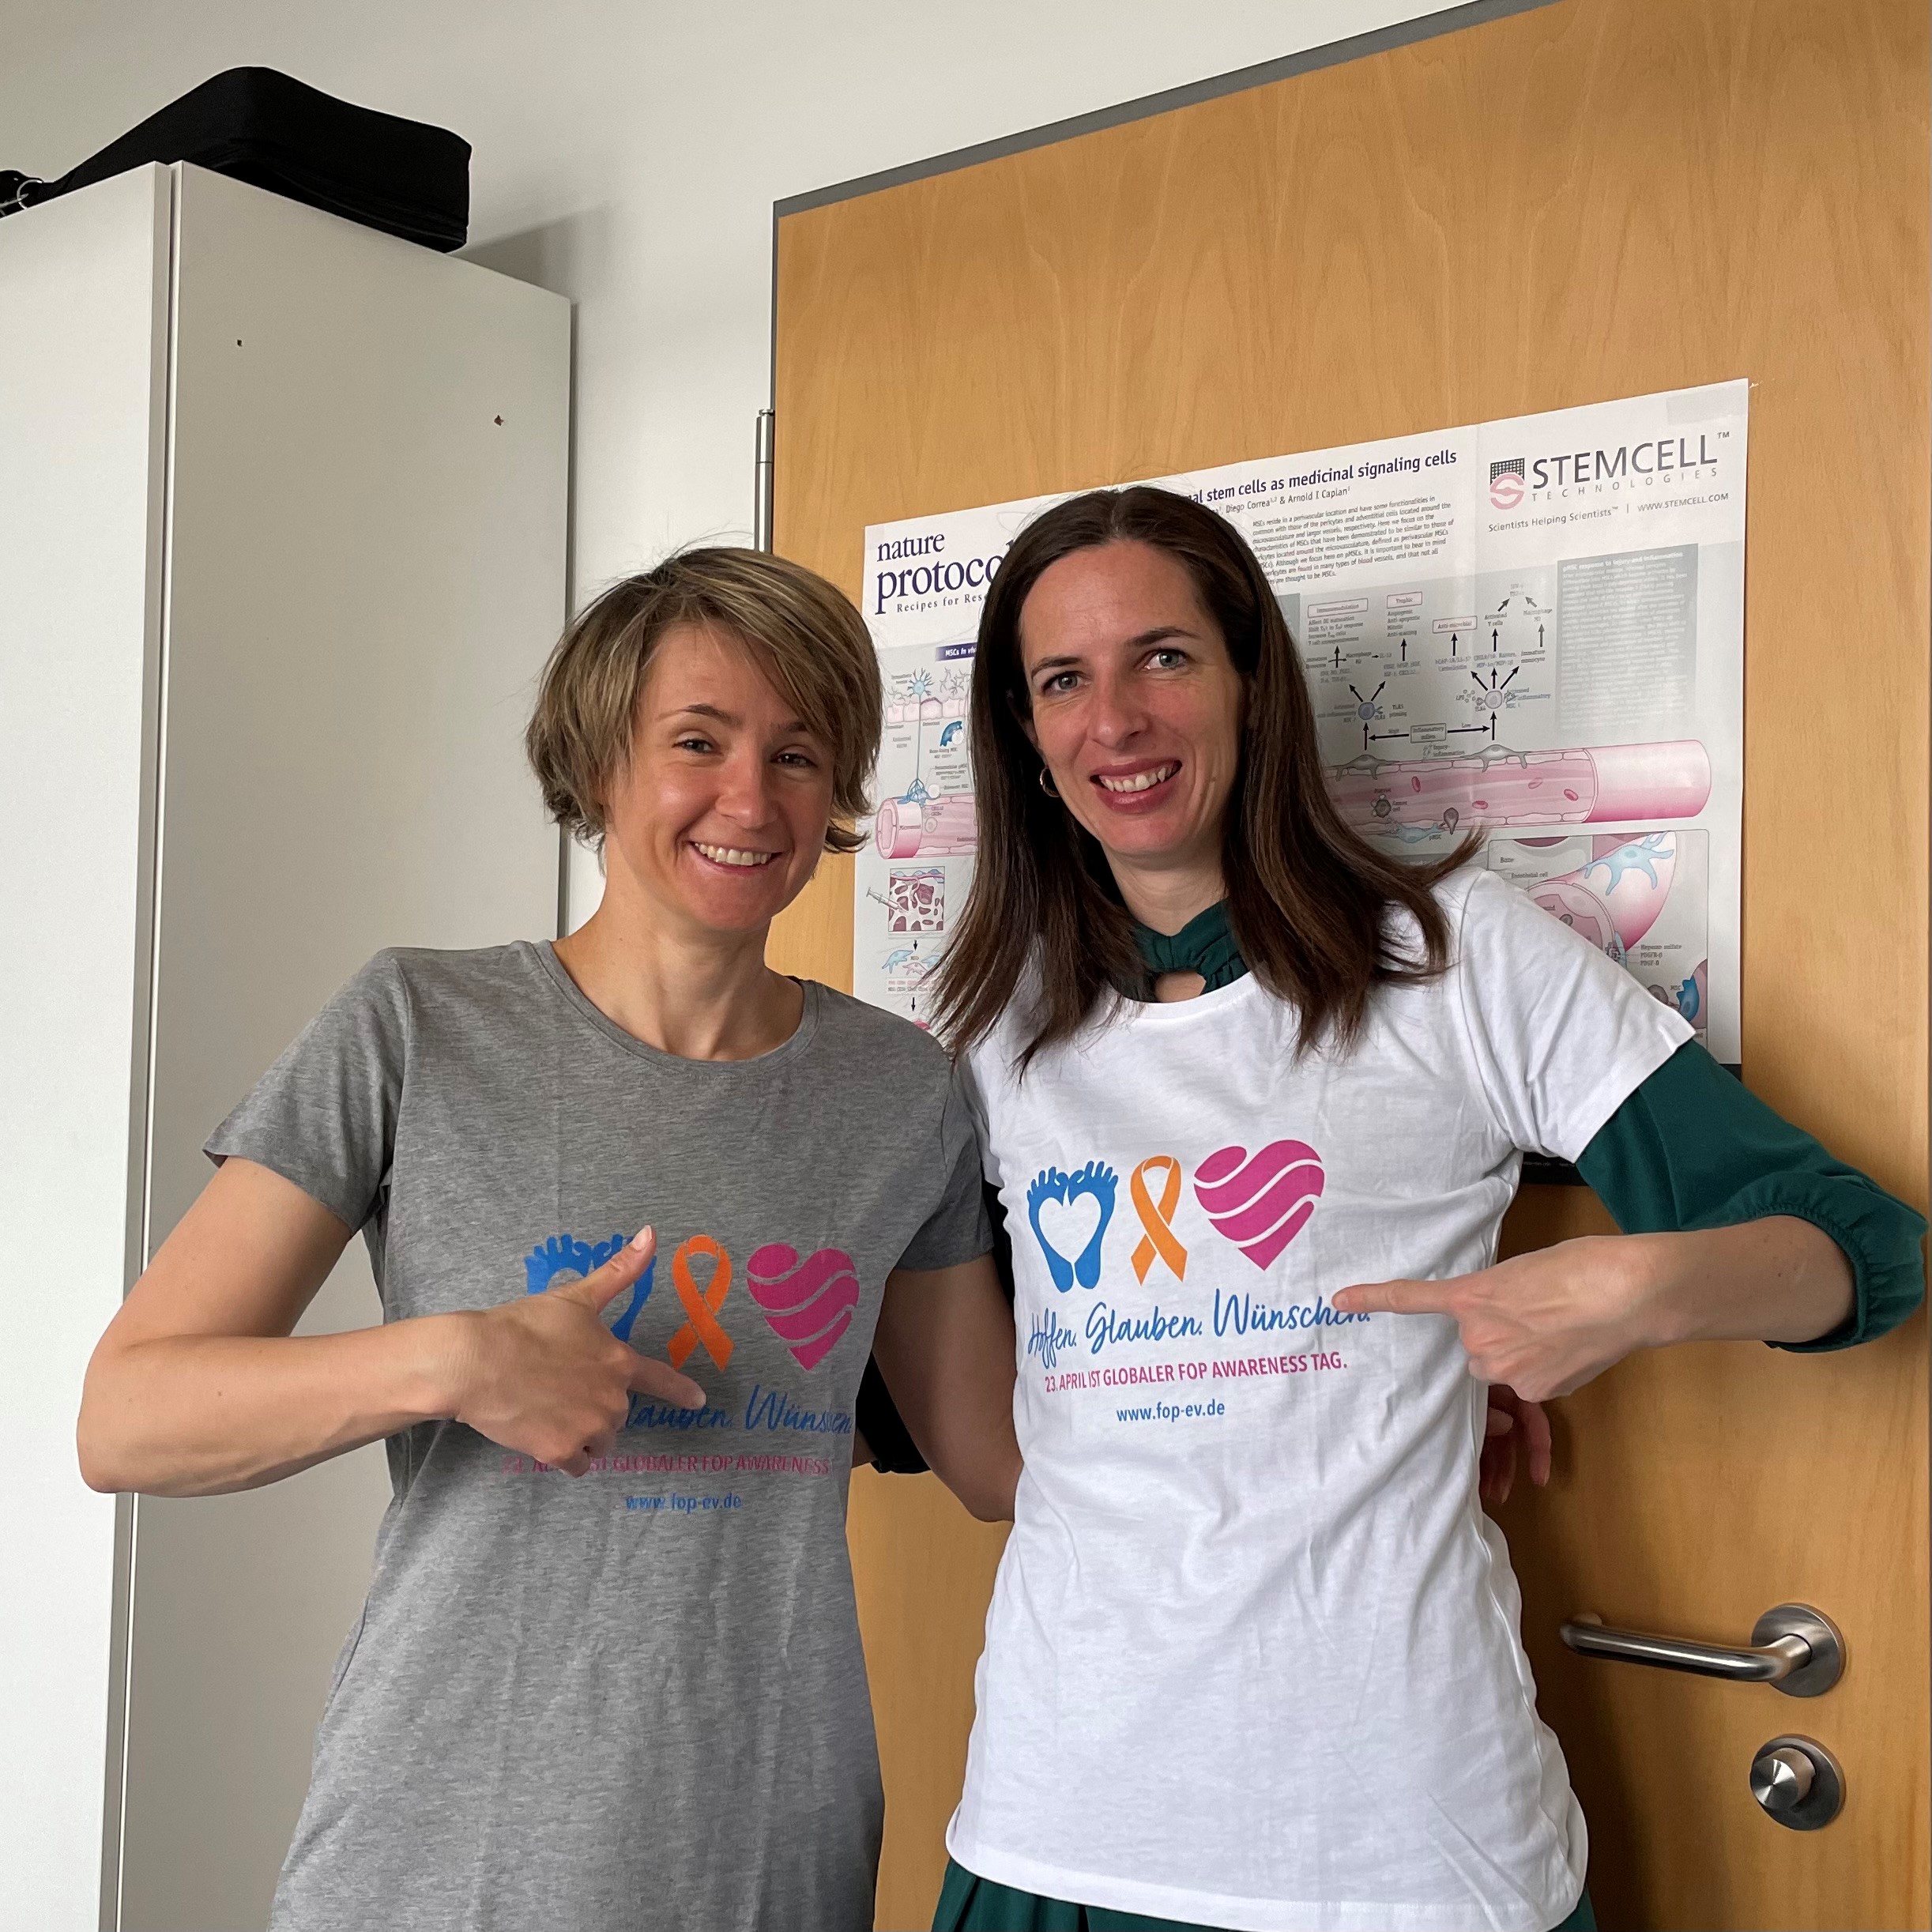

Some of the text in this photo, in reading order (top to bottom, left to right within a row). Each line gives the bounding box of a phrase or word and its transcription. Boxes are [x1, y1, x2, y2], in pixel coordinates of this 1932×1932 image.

[1207, 487, 1234, 501] stem
[1238, 479, 1267, 495] cells
[1271, 478, 1284, 491] as
[1289, 465, 1354, 488] medicinal
[1358, 457, 1421, 479] signaling
[1425, 449, 1457, 467] cells
[1531, 467, 1717, 502] TECHNOLOGIES
[1226, 503, 1245, 514] Diego
[1288, 491, 1313, 503] Arnold
[1637, 492, 1730, 513] WWW.STEMCELL.COM
[1488, 519, 1529, 533] Scientists
[1531, 514, 1567, 526] Helping
[876, 533, 945, 562] nature
[897, 601, 938, 612] Recipes
[943, 596, 959, 606] for
[1085, 1301, 1203, 1354] Glauben.
[1045, 1351, 1347, 1392] 23. APRIL IST GLOBALER FOP AWARENESS TAG.
[1116, 1398, 1226, 1422] www.fop-ev.de
[702, 1454, 733, 1471] FOP
[736, 1454, 830, 1475] AWARENESS
